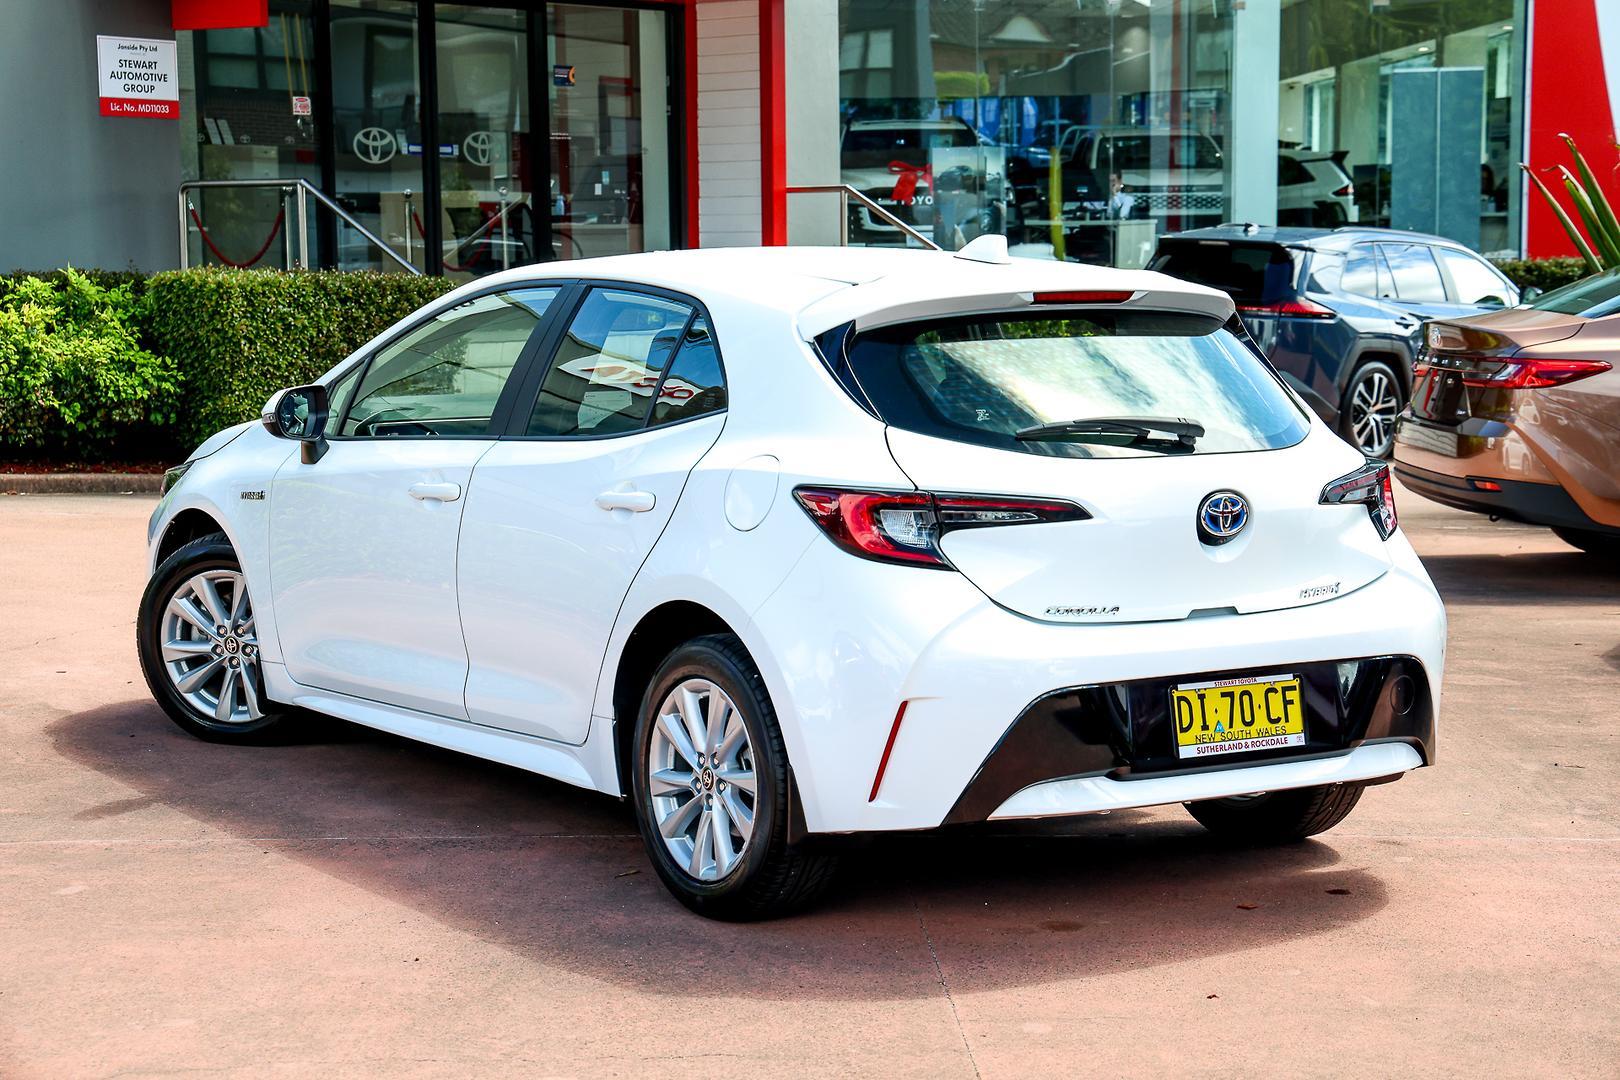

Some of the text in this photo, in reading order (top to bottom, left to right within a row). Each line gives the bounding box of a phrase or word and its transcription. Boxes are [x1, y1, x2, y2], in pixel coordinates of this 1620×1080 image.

[139, 45, 148, 53] Pty
[118, 59, 158, 70] STEWART
[110, 71, 168, 82] AUTOMOTIVE
[123, 83, 156, 93] GROUP
[110, 102, 170, 114] Lic. No. MD11033
[1214, 679, 1237, 687] STEWART
[1195, 726, 1287, 744] NEW SOUTH WALES
[1196, 741, 1244, 755] SUTHERLAND
[1244, 740, 1250, 749] &
[1250, 737, 1289, 748] ROCKDALE
